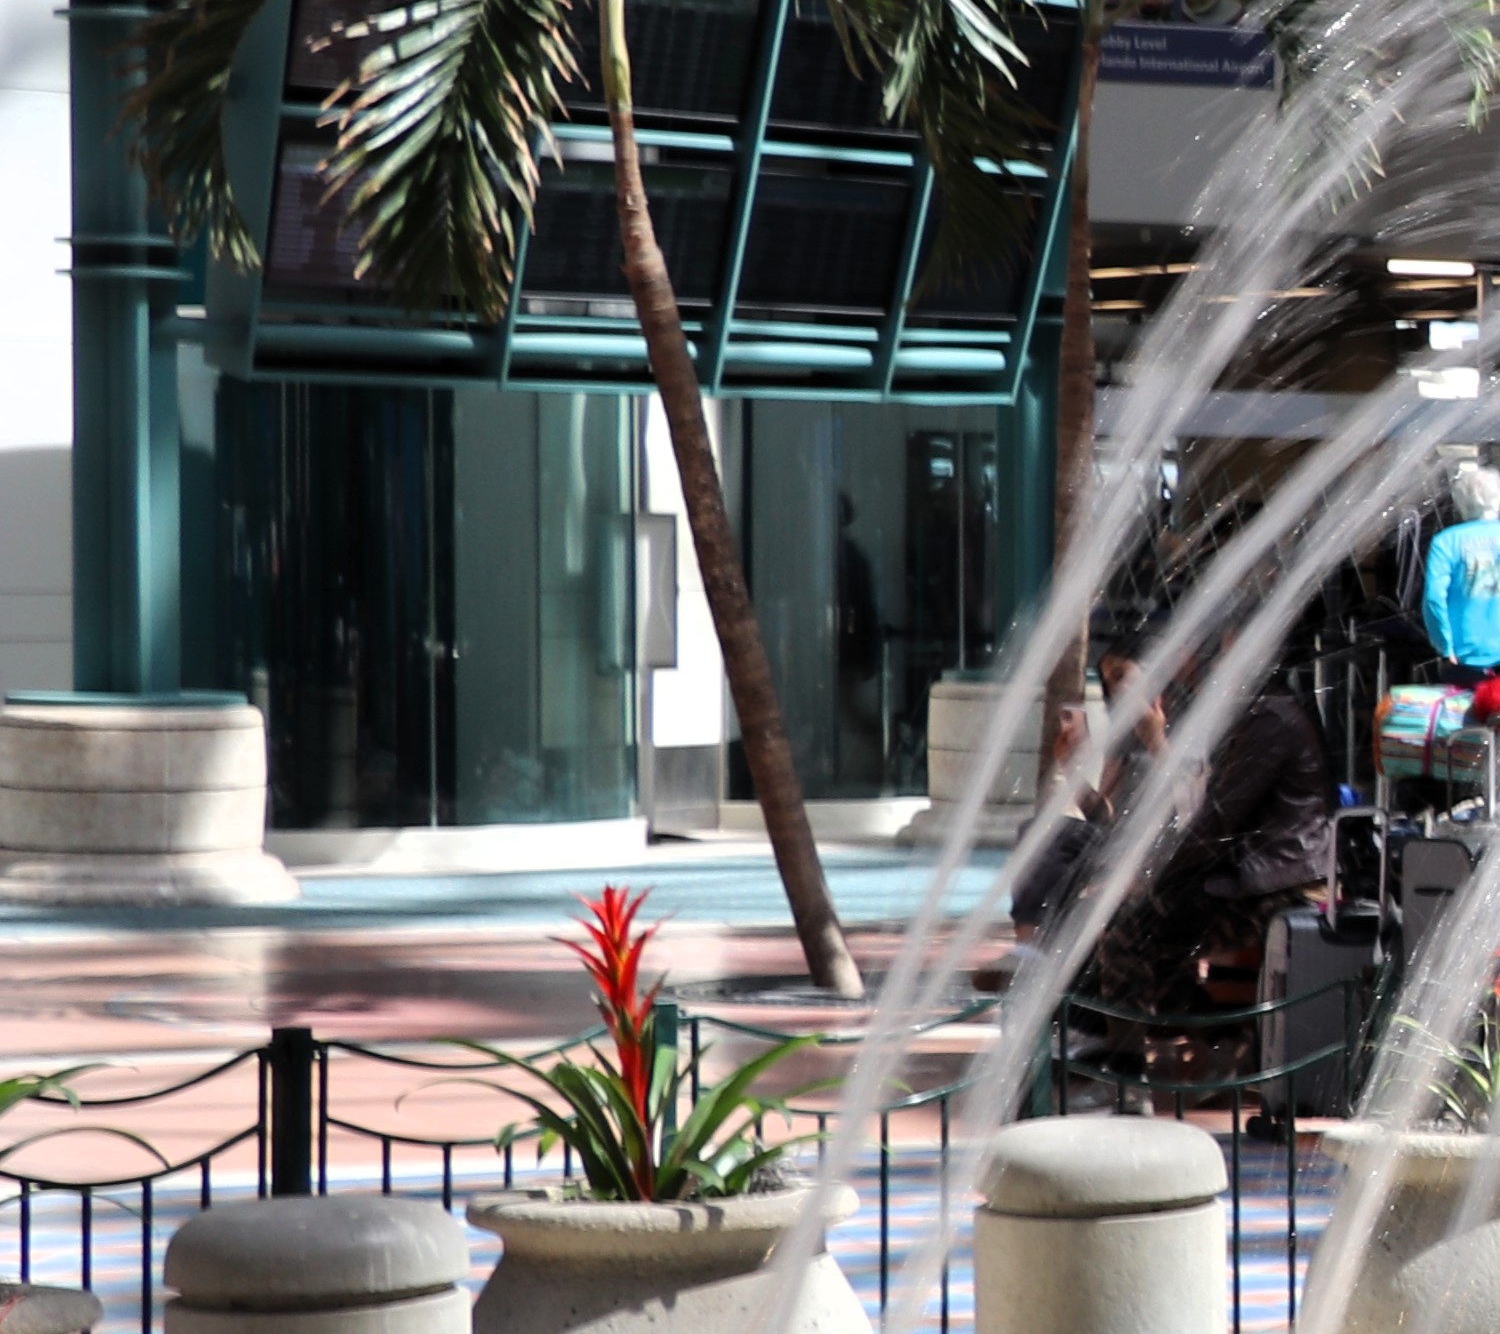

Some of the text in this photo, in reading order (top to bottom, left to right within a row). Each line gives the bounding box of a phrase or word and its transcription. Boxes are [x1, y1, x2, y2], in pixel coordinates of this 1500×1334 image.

[1099, 35, 1167, 51] obby Level
[1101, 53, 1137, 68] lando
